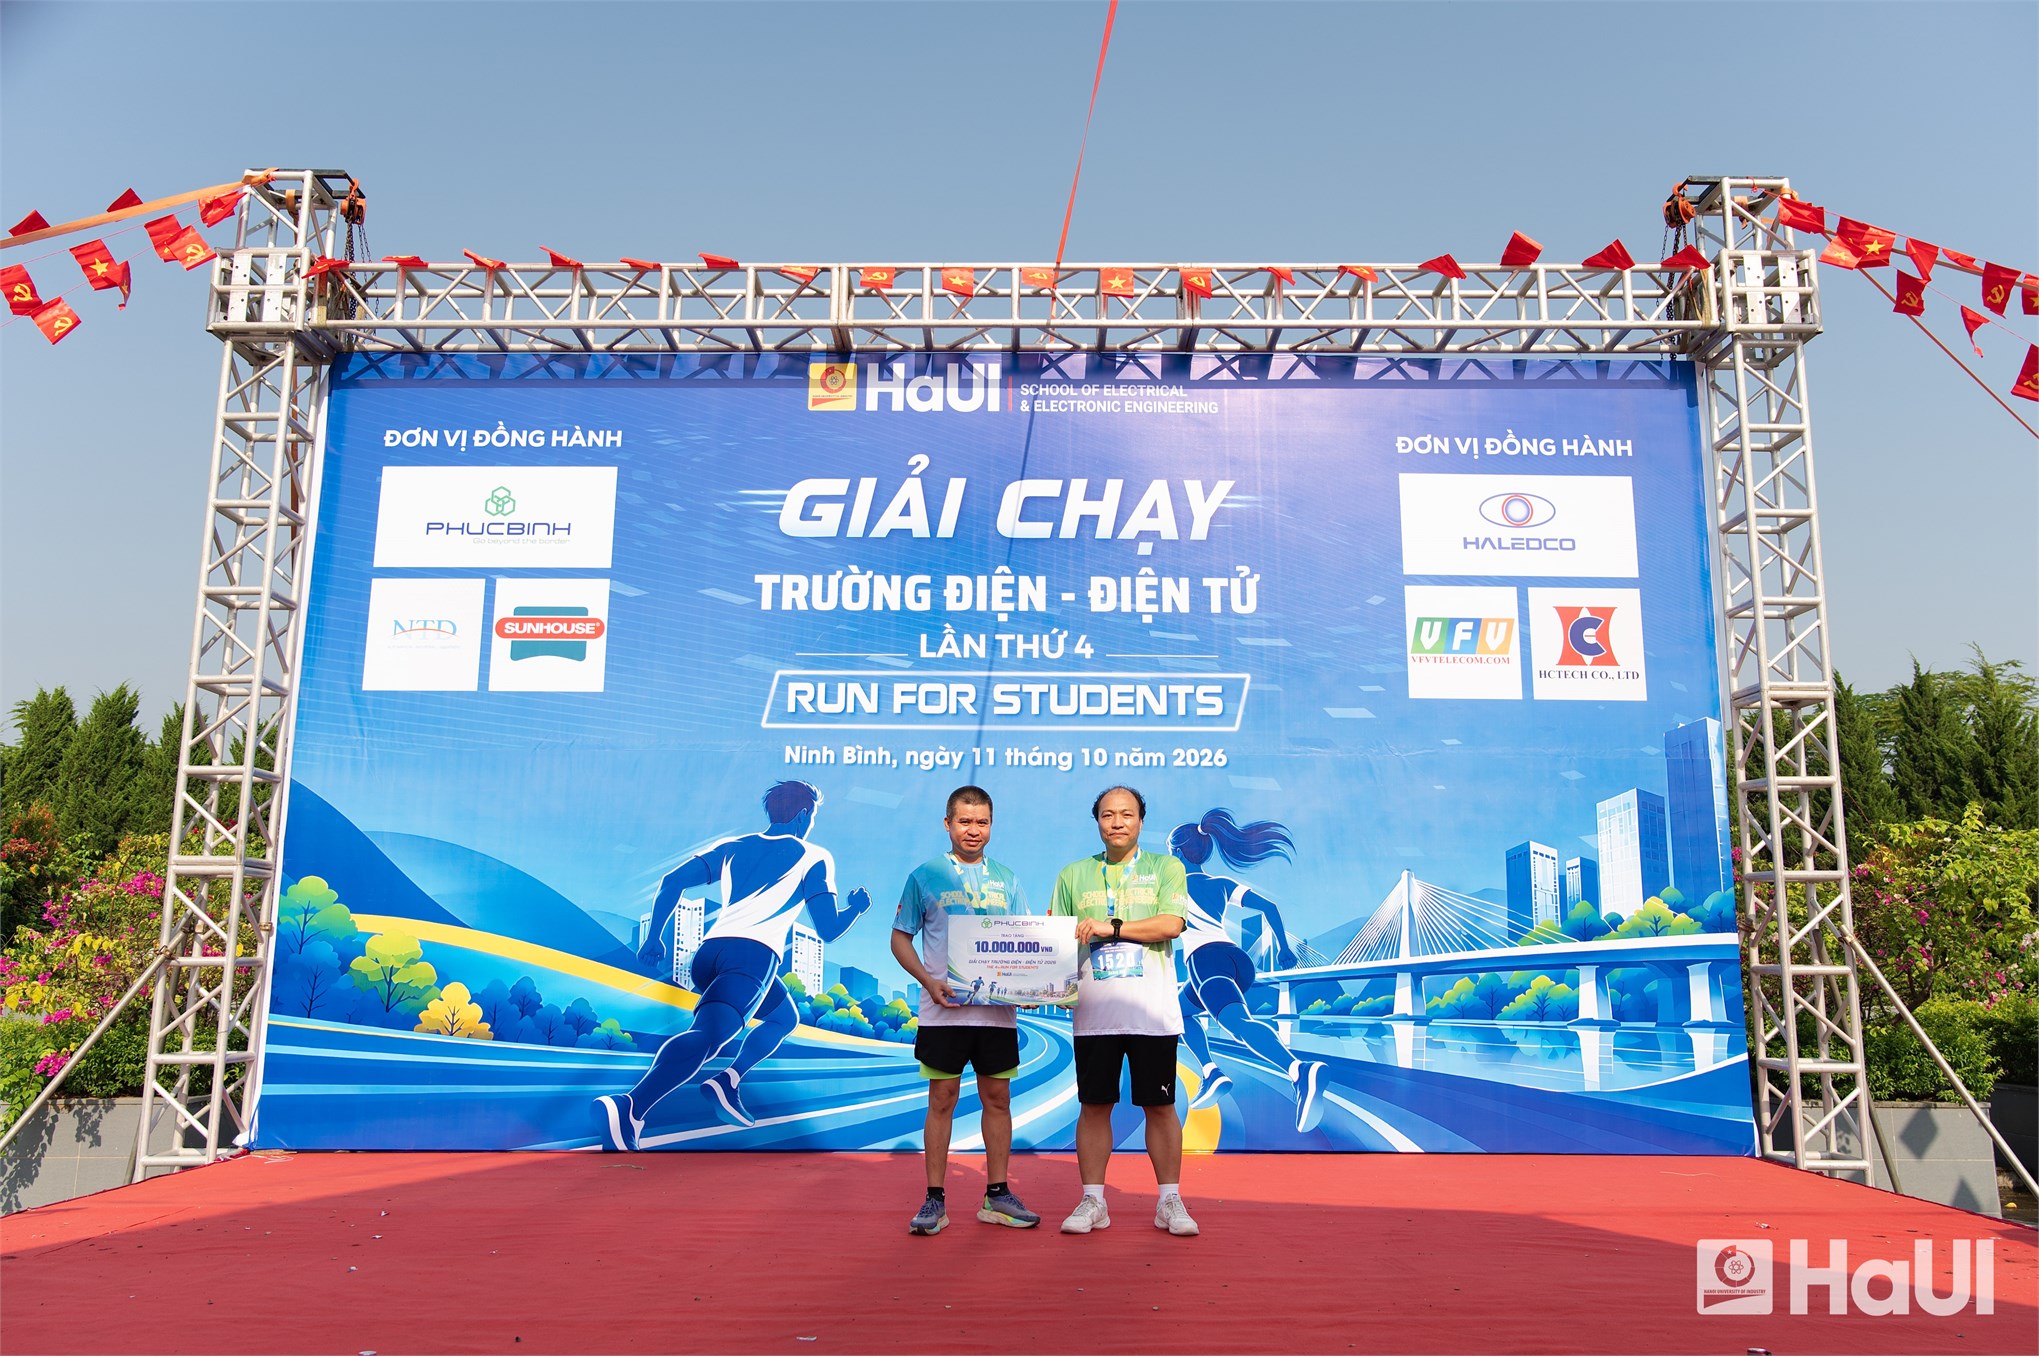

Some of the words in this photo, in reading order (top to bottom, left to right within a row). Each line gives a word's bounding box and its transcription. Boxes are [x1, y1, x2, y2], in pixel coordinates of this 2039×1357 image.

[865, 363, 1000, 412] HaUI
[1020, 384, 1078, 396] SCHOOL
[1082, 384, 1100, 397] OF
[1103, 384, 1188, 398] ELECTRICAL
[1020, 400, 1030, 412] &
[1034, 400, 1121, 413] ELECTRONIC
[1125, 401, 1219, 414] ENGINEERING
[384, 427, 438, 448] ĐƠN
[443, 429, 468, 452] VỊ
[472, 421, 546, 448] ĐỒNG
[551, 425, 623, 448] HÀNH
[1395, 434, 1449, 454] ĐƠN
[1454, 436, 1479, 459] VỊ
[1484, 429, 1557, 456] ĐỒNG
[1563, 434, 1633, 457] HÀNH
[778, 453, 967, 538] GIẢI
[996, 478, 1236, 556] CHẠY
[426, 522, 571, 536] PHUCBINH
[487, 537, 521, 546] beyond
[1463, 537, 1576, 551] HALEDCO
[755, 565, 931, 611] TRƯỜNG
[943, 565, 1046, 622] ĐIỆN
[1061, 592, 1076, 601] -
[1088, 567, 1190, 624] ĐIỆN
[1203, 565, 1261, 614] TỬ
[920, 622, 986, 659] LẦN
[995, 628, 1068, 659] THỨ
[1073, 634, 1095, 659] 4
[1420, 621, 1508, 650] VFV
[1411, 655, 1510, 665] VFVTELECOM.COM
[1539, 670, 1588, 680] HCTECH
[1591, 671, 1615, 682] CO.,
[1617, 671, 1640, 680] LTD
[787, 682, 878, 714] RUN
[893, 683, 977, 715] FOR
[993, 684, 1224, 716] STUDENTS
[784, 745, 835, 765] Ninh
[842, 744, 898, 769] Bình,
[905, 747, 965, 771] ngày
[971, 748, 996, 766] 11
[1005, 745, 1073, 771] tháng
[1081, 747, 1108, 766] 10
[1114, 747, 1165, 767] năm
[1172, 747, 1228, 767] 2026
[974, 941, 1040, 953] 10.000.000
